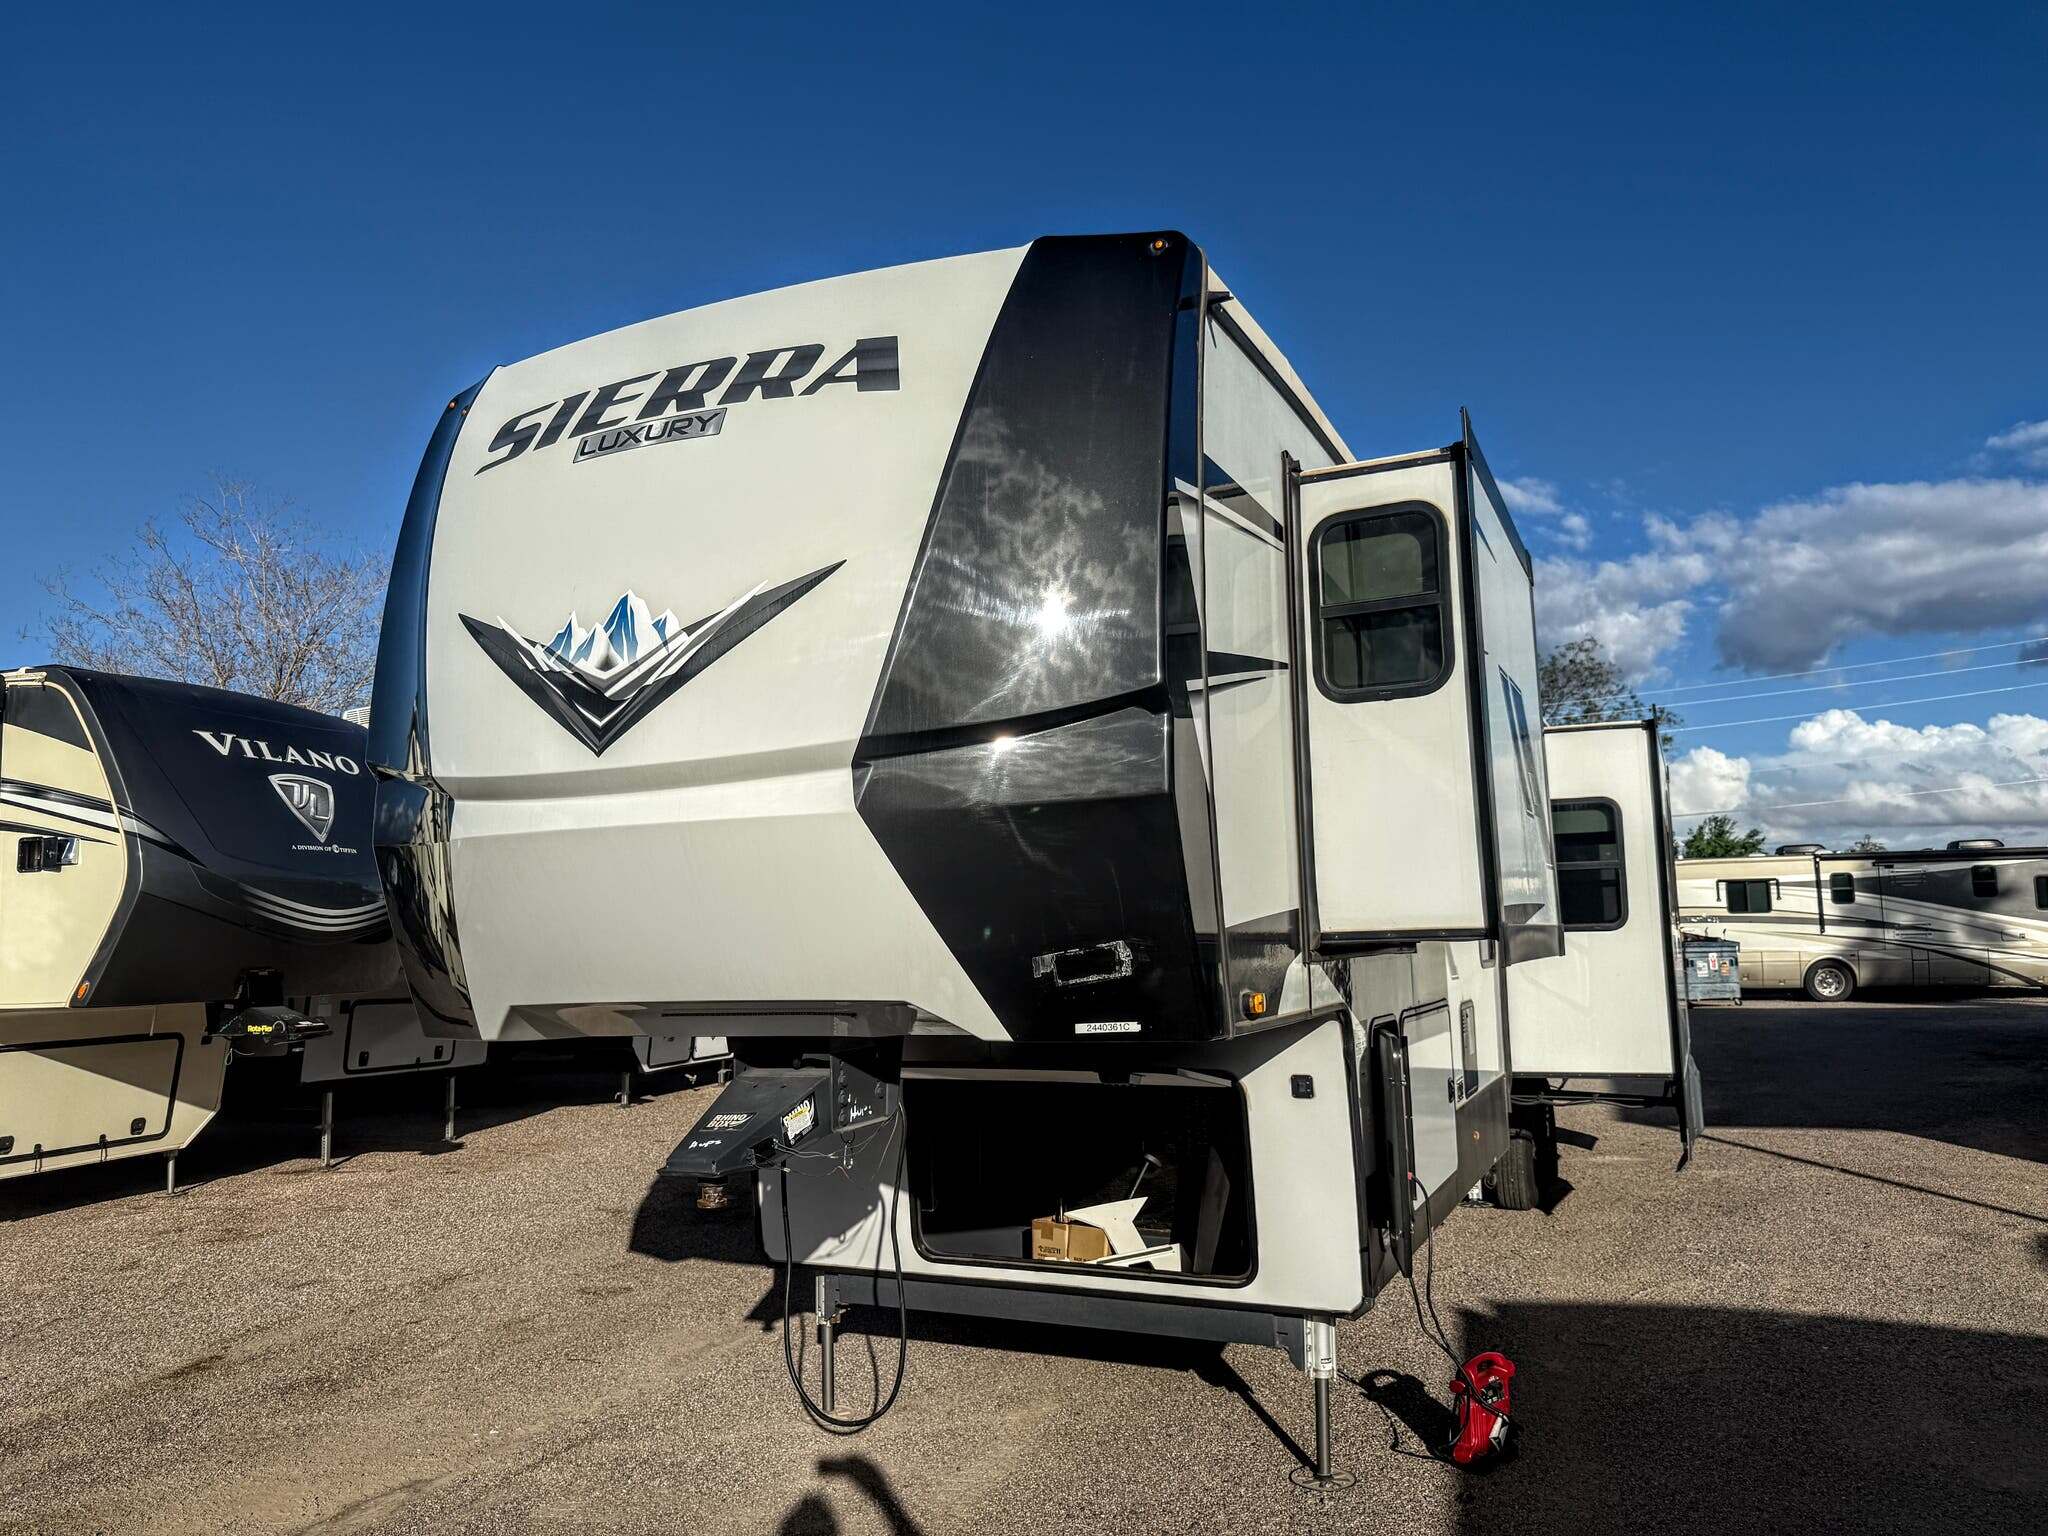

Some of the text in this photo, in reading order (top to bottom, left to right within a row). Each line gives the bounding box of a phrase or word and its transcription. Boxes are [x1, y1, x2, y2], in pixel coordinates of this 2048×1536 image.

[474, 336, 900, 476] SIERRA
[580, 412, 720, 456] LUXURY
[192, 729, 360, 775] VILANO
[1086, 1022, 1130, 1031] 2440361C
[706, 1120, 732, 1128] BOX
[713, 1113, 748, 1121] RHINO
